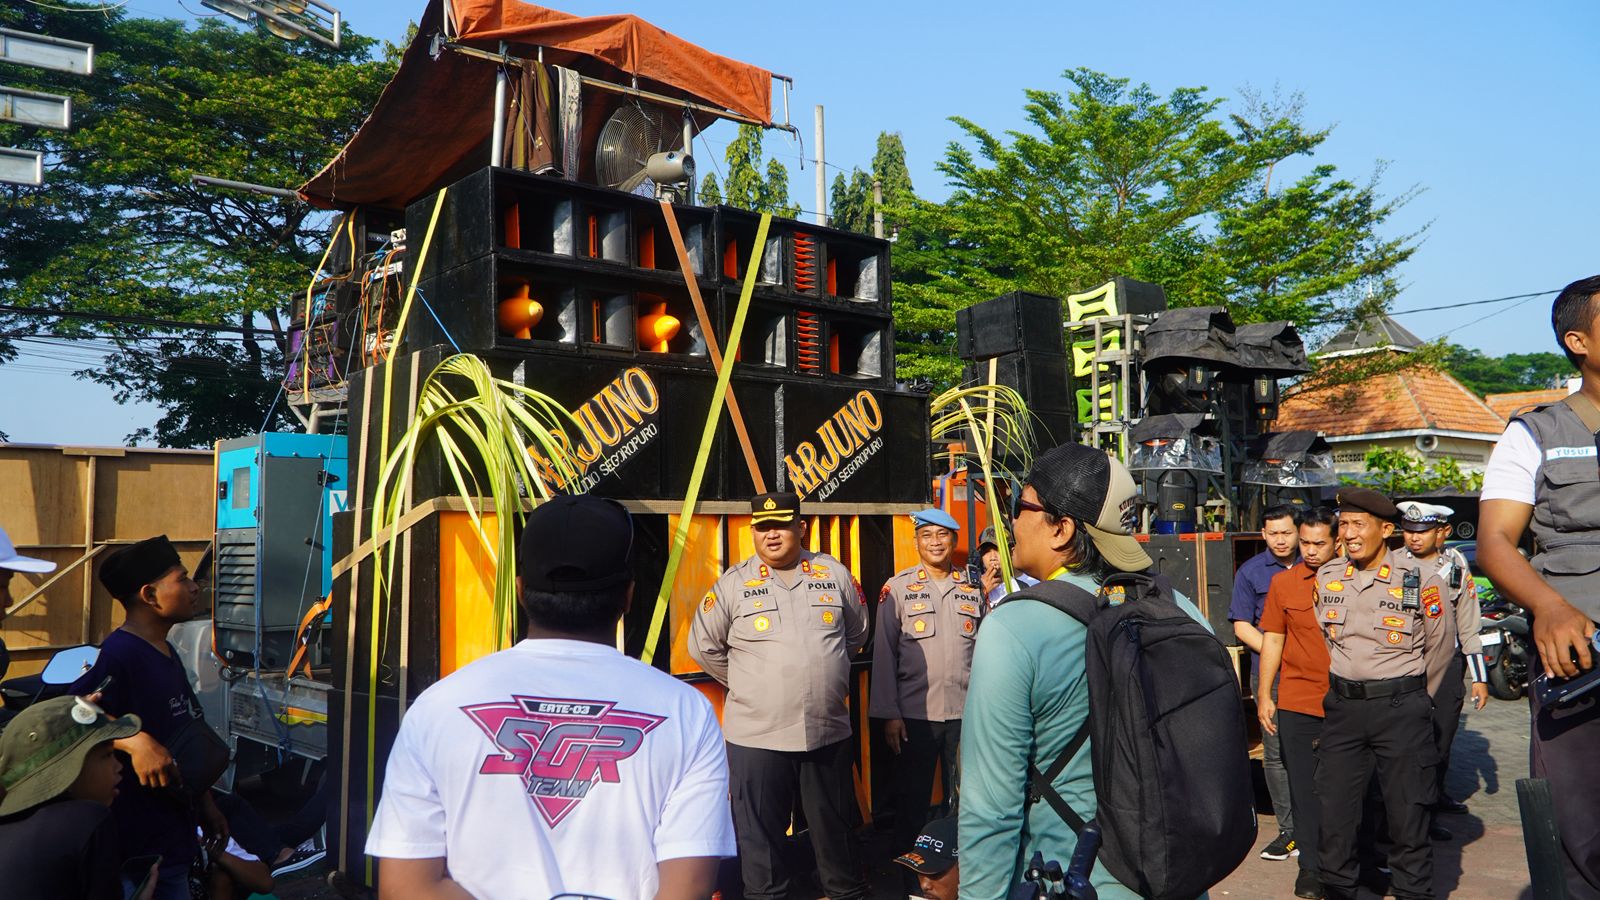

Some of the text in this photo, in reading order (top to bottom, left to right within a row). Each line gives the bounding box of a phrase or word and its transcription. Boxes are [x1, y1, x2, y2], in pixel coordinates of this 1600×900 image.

[527, 367, 659, 497] ARJUNO
[784, 390, 883, 501] ARJUNO
[571, 422, 659, 496] UDIO SEGOROPURO
[817, 436, 884, 502] AUDIO SEGOROPURO
[743, 587, 769, 598] DANI
[808, 582, 837, 591] POLRI
[954, 593, 979, 603] POLRI
[1323, 595, 1345, 604] RUDI
[478, 717, 645, 784] SGR
[527, 775, 593, 799] TEAM
